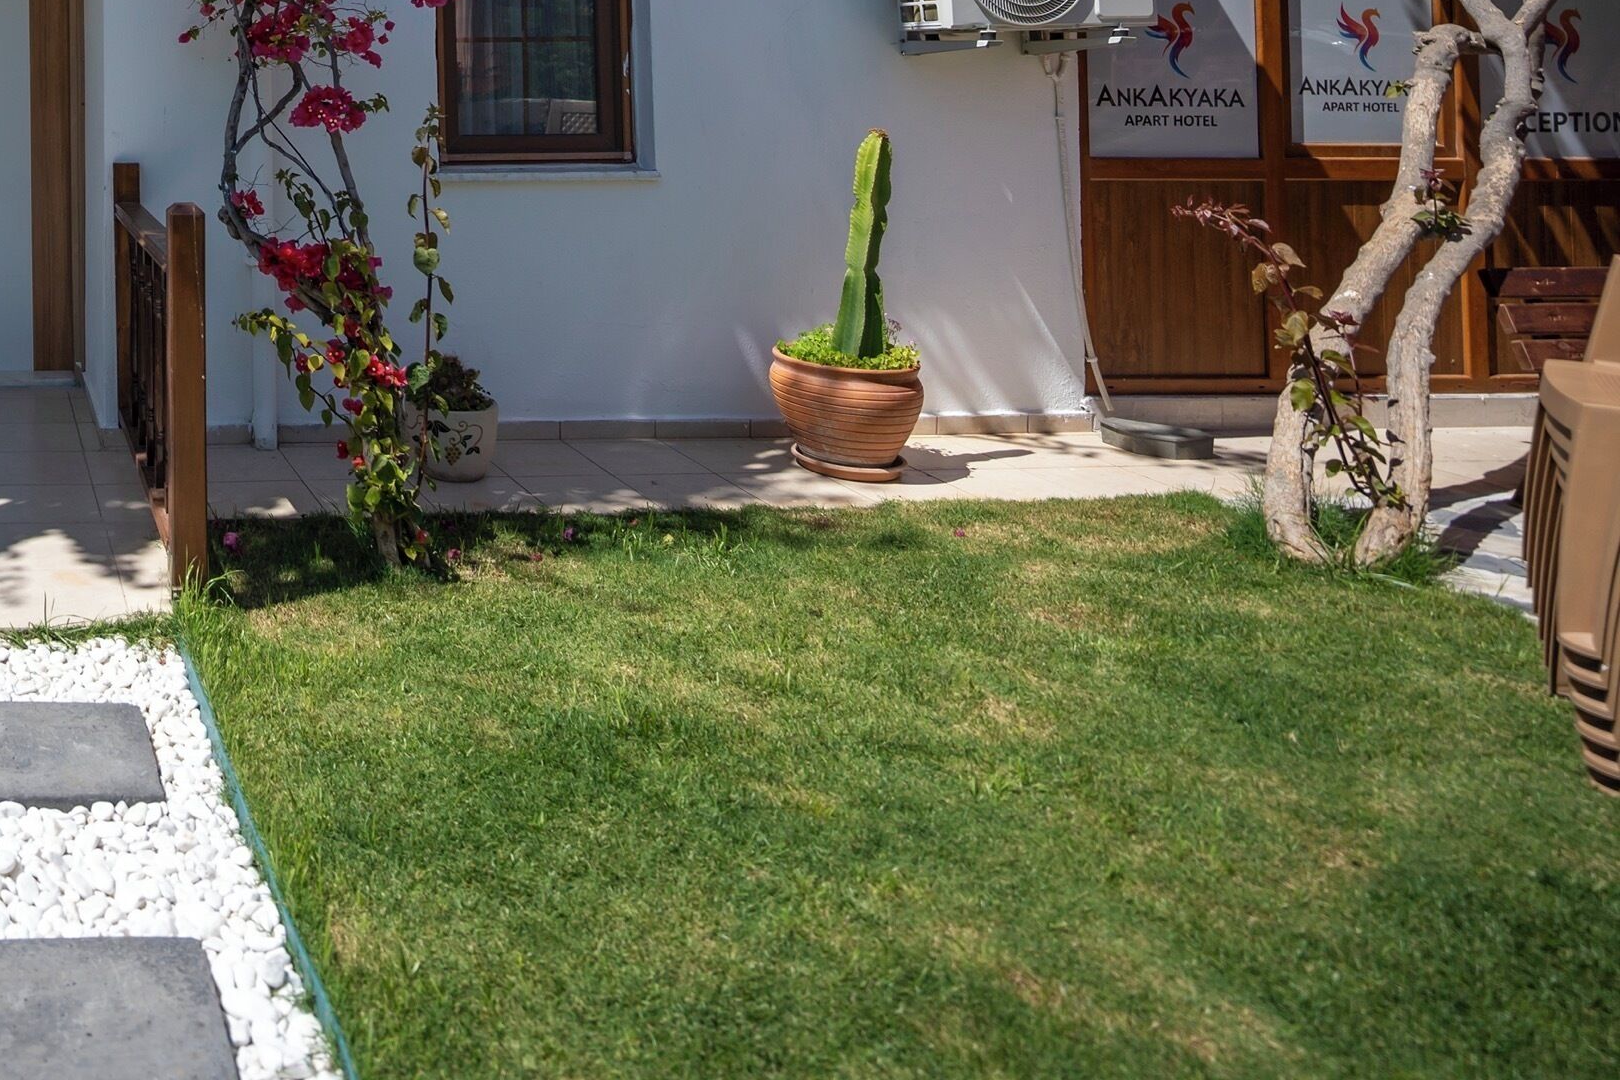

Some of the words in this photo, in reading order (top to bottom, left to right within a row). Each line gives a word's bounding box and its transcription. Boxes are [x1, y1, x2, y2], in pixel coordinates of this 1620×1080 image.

[1322, 102, 1360, 112] APART
[1363, 102, 1400, 113] HOTEL
[1124, 115, 1170, 126] APART
[1173, 115, 1218, 127] HOTEL
